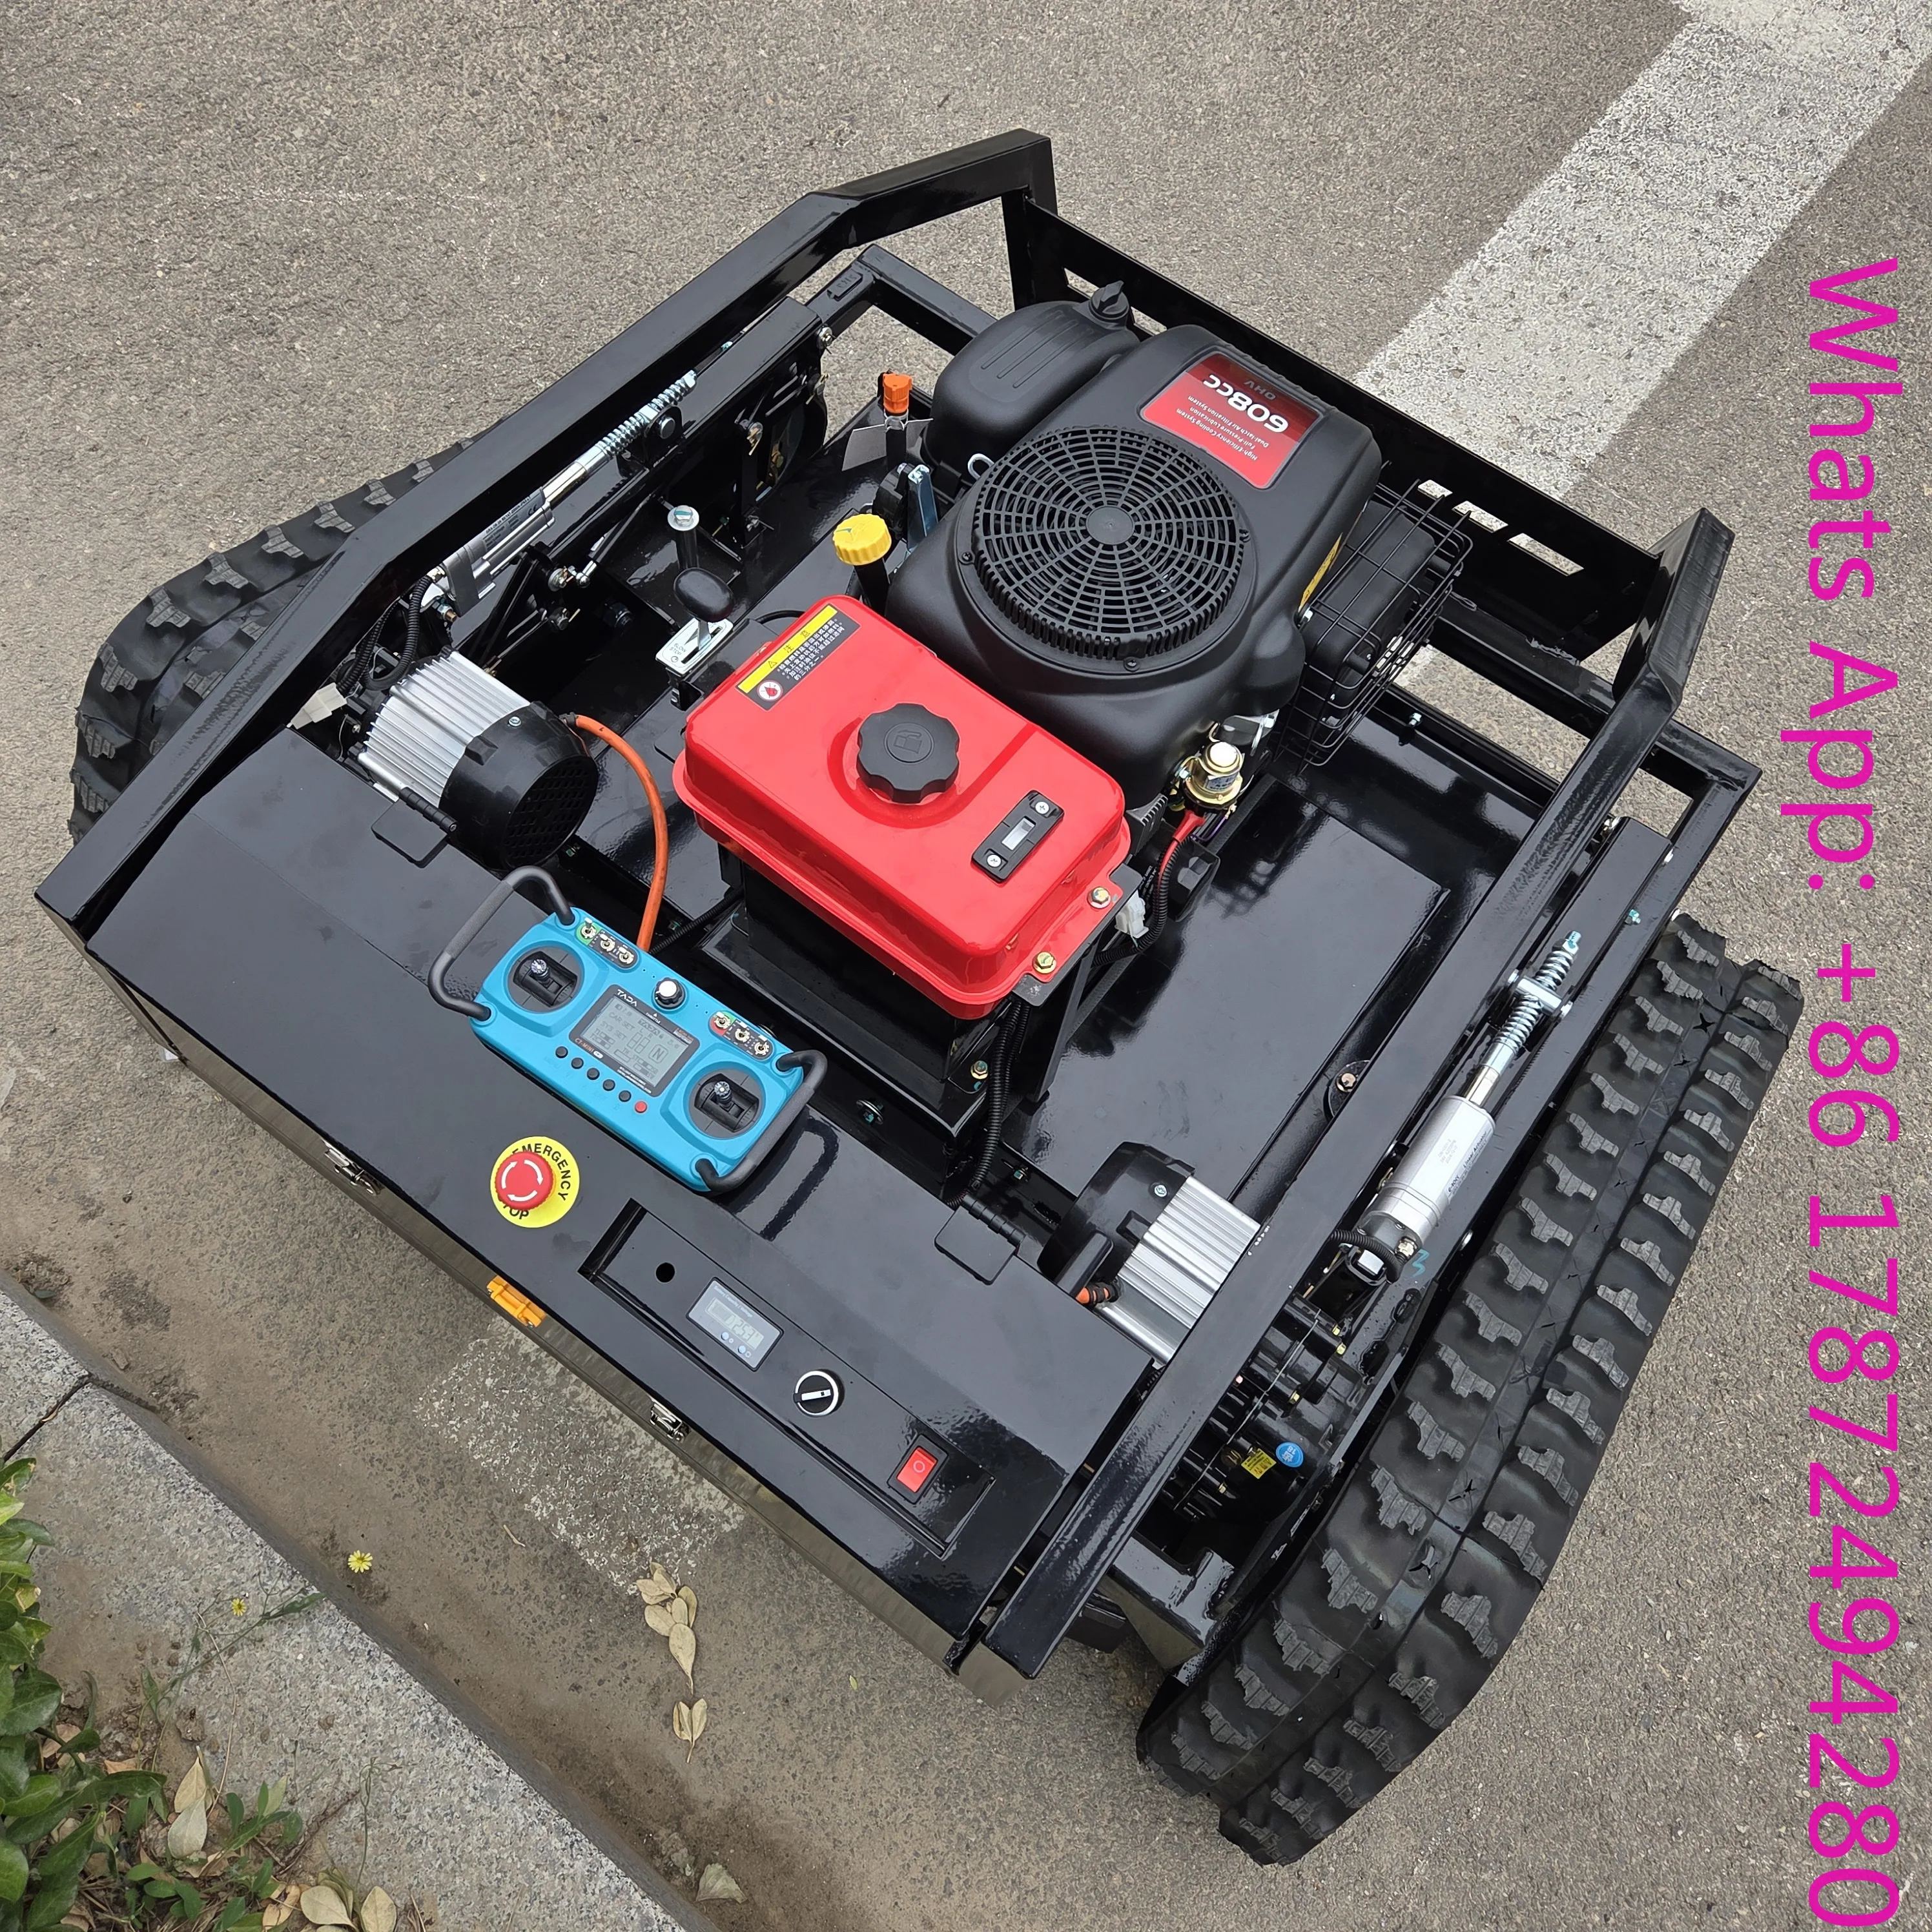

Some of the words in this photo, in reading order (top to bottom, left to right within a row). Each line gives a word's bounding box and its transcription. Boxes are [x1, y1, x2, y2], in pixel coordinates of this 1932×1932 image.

[1244, 380, 1276, 400] OHV
[1187, 395, 1208, 410] System
[1203, 374, 1289, 433] 608cc
[1175, 407, 1197, 423] System
[1189, 406, 1220, 428] Lubrication
[1206, 407, 1233, 425] Filtration
[1195, 419, 1217, 436] Cooling
[1220, 425, 1256, 449] Full-Pressure
[1231, 422, 1241, 431] Air
[1216, 432, 1258, 460] High-Efficiency
[783, 628, 810, 653] 注意
[600, 1020, 614, 1032] SYS
[613, 1029, 627, 1041] SET
[608, 1011, 622, 1023] CAR
[622, 1020, 635, 1032] SET
[1462, 1151, 1474, 1168] Linear
[1472, 1130, 1487, 1152] Actuator
[511, 1143, 571, 1201] MERGENCY
[502, 1205, 529, 1220] OP
